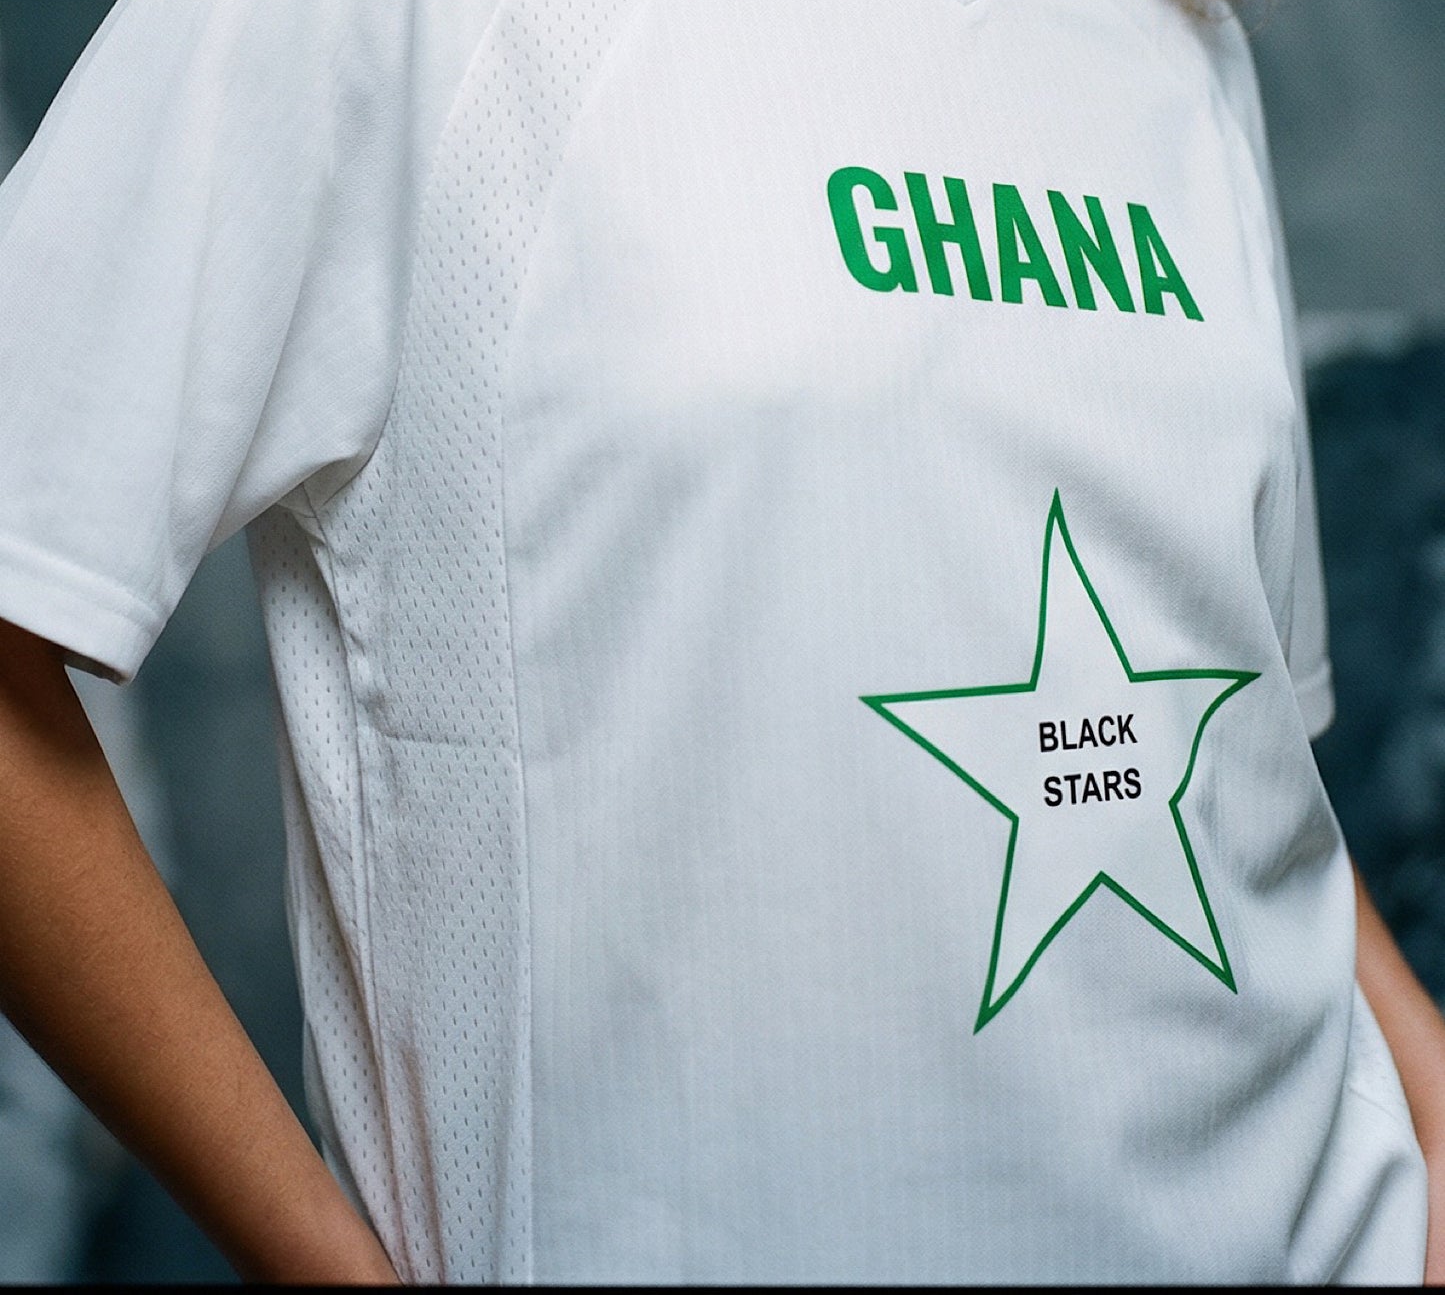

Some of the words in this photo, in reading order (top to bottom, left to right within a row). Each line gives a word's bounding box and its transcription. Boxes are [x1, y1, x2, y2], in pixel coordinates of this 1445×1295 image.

[826, 165, 1205, 322] GHANA
[1039, 713, 1138, 753] BLACK
[1043, 767, 1142, 807] STARS
